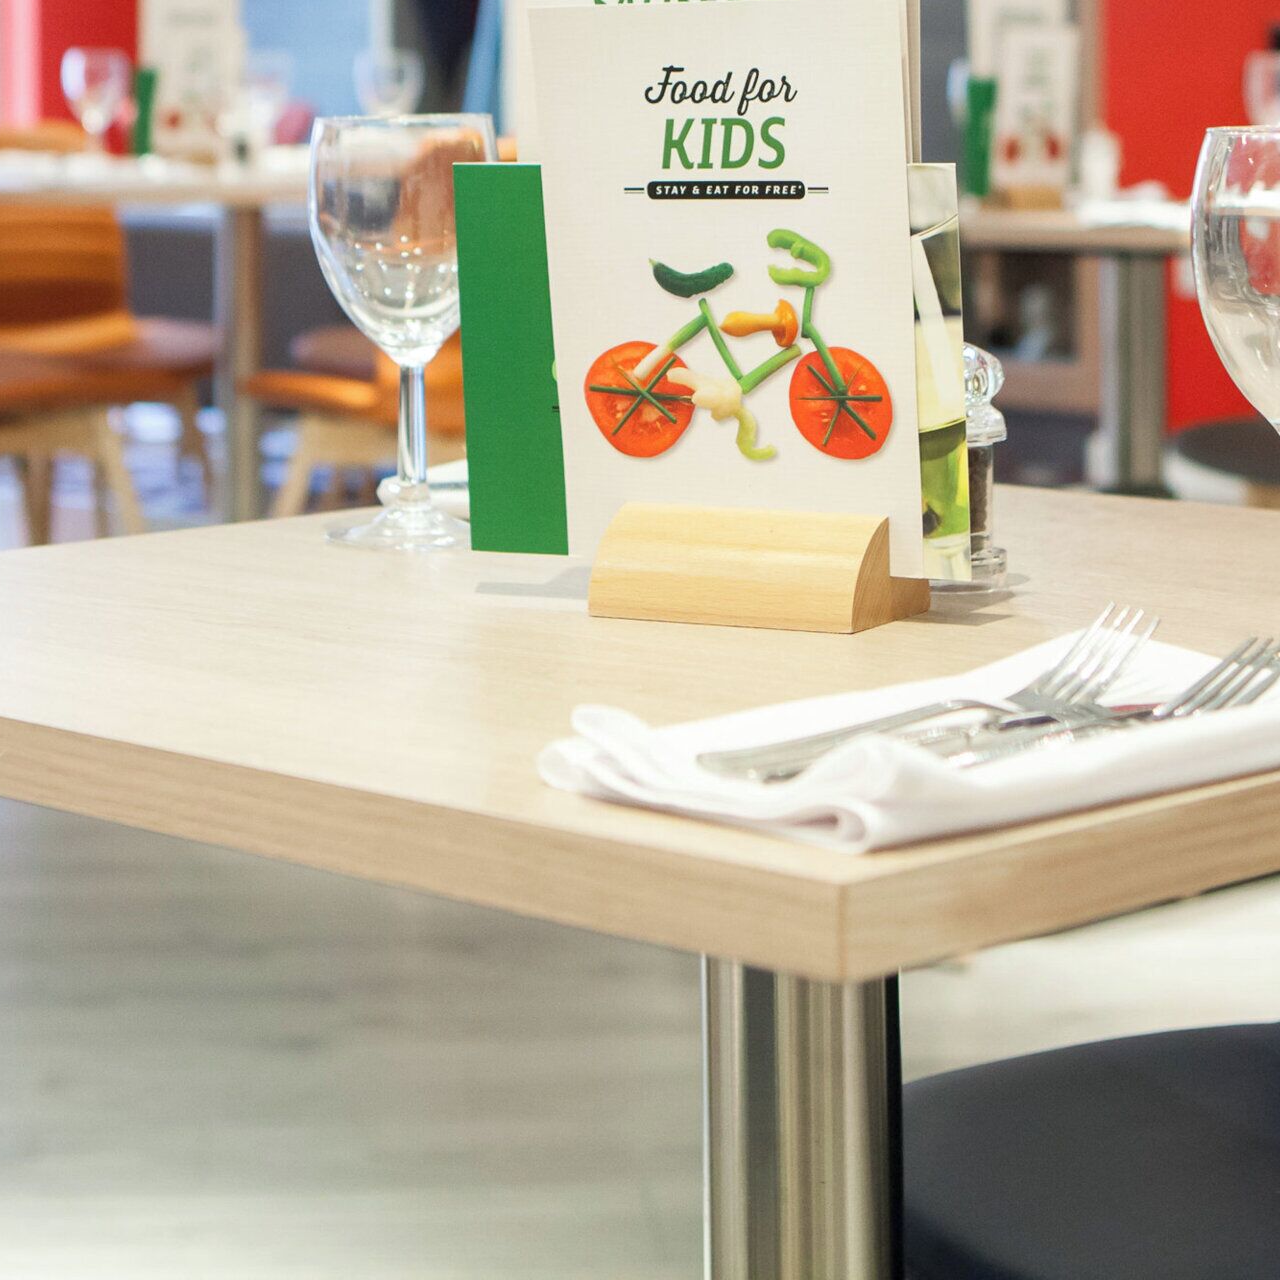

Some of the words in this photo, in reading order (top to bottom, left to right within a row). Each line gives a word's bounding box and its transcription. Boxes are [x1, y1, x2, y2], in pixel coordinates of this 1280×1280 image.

[644, 65, 735, 105] Food
[736, 67, 798, 116] for
[661, 116, 786, 170] KIDS
[655, 184, 687, 195] STAY
[692, 184, 700, 195] &
[705, 184, 730, 195] EAT
[734, 184, 760, 195] FOR
